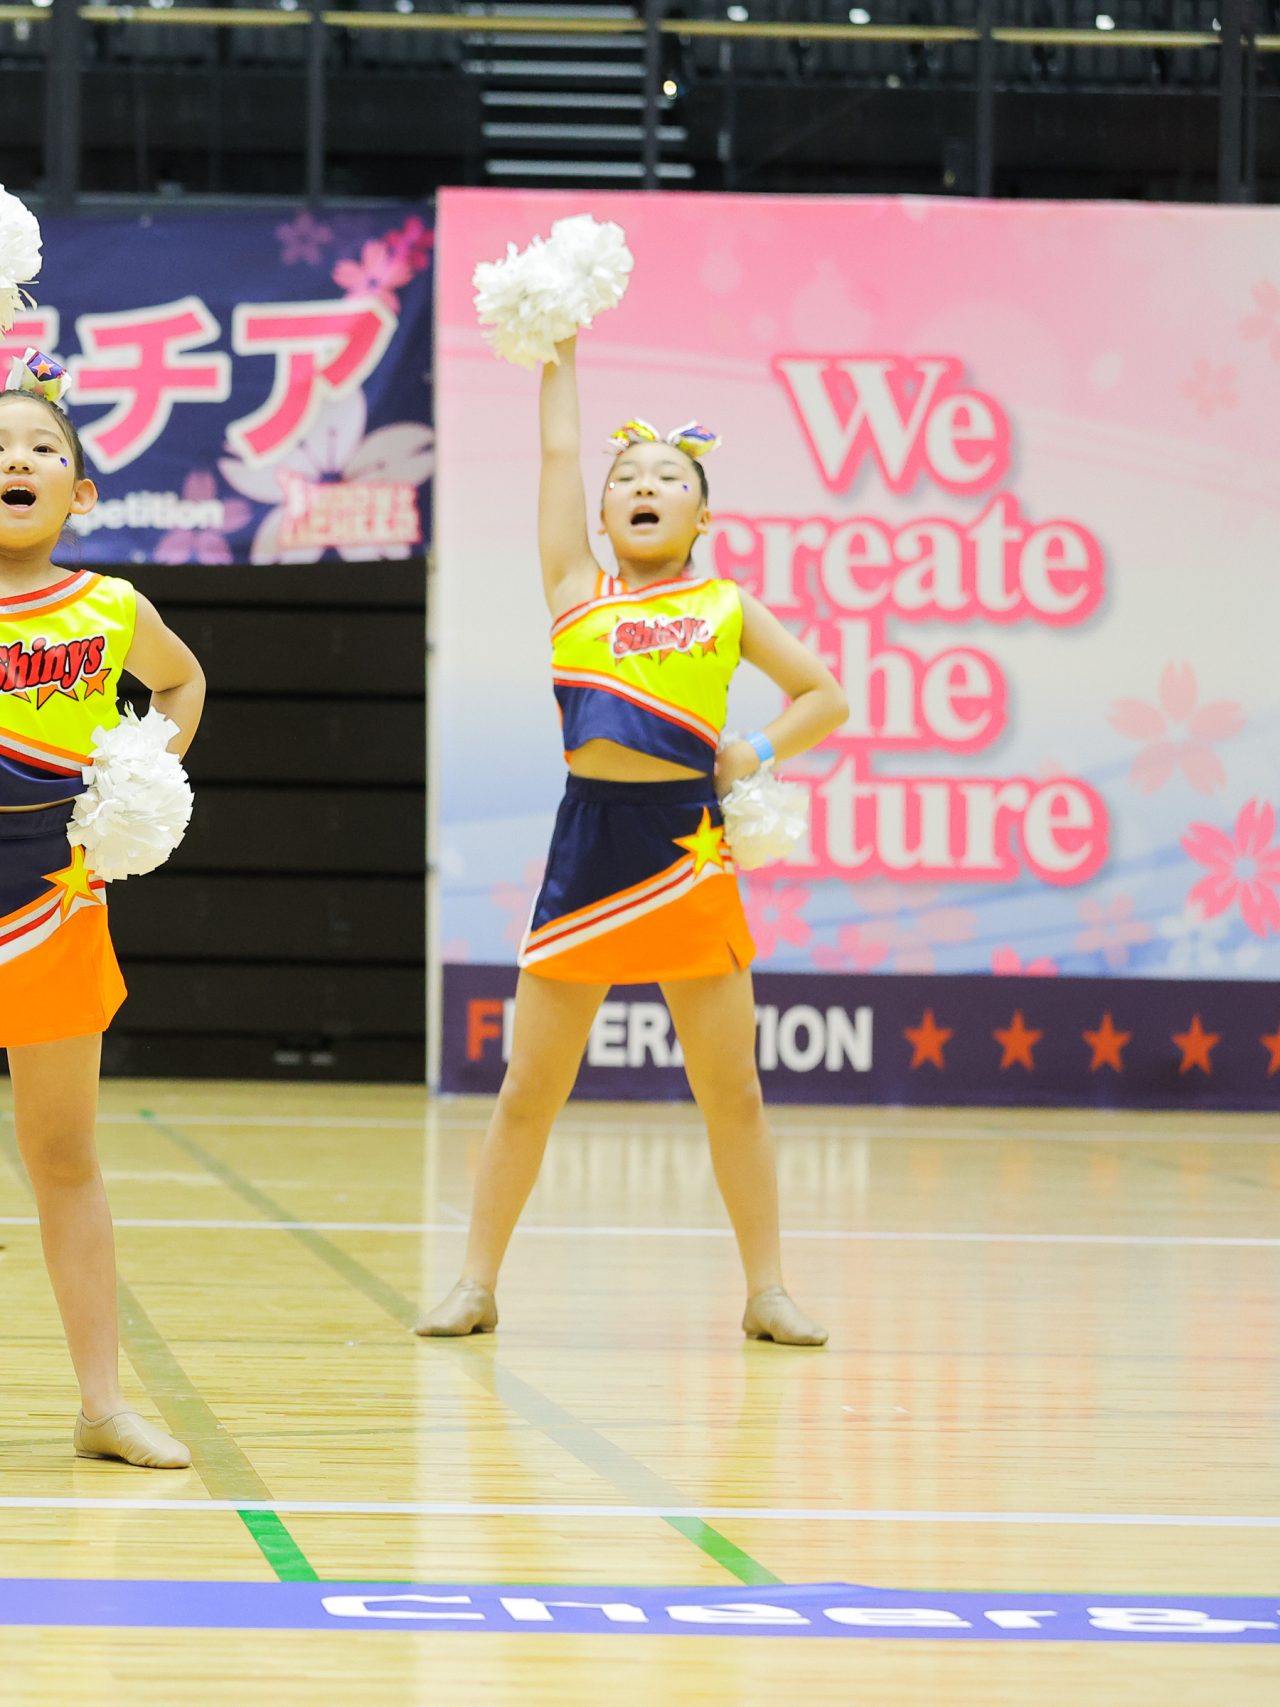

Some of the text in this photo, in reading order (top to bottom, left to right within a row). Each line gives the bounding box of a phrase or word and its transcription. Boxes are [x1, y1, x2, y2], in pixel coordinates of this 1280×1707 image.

[775, 355, 998, 486] We
[691, 490, 1092, 616] create
[614, 616, 710, 656] Shinys
[780, 752, 1098, 874] ture
[466, 998, 874, 1073] FERION
